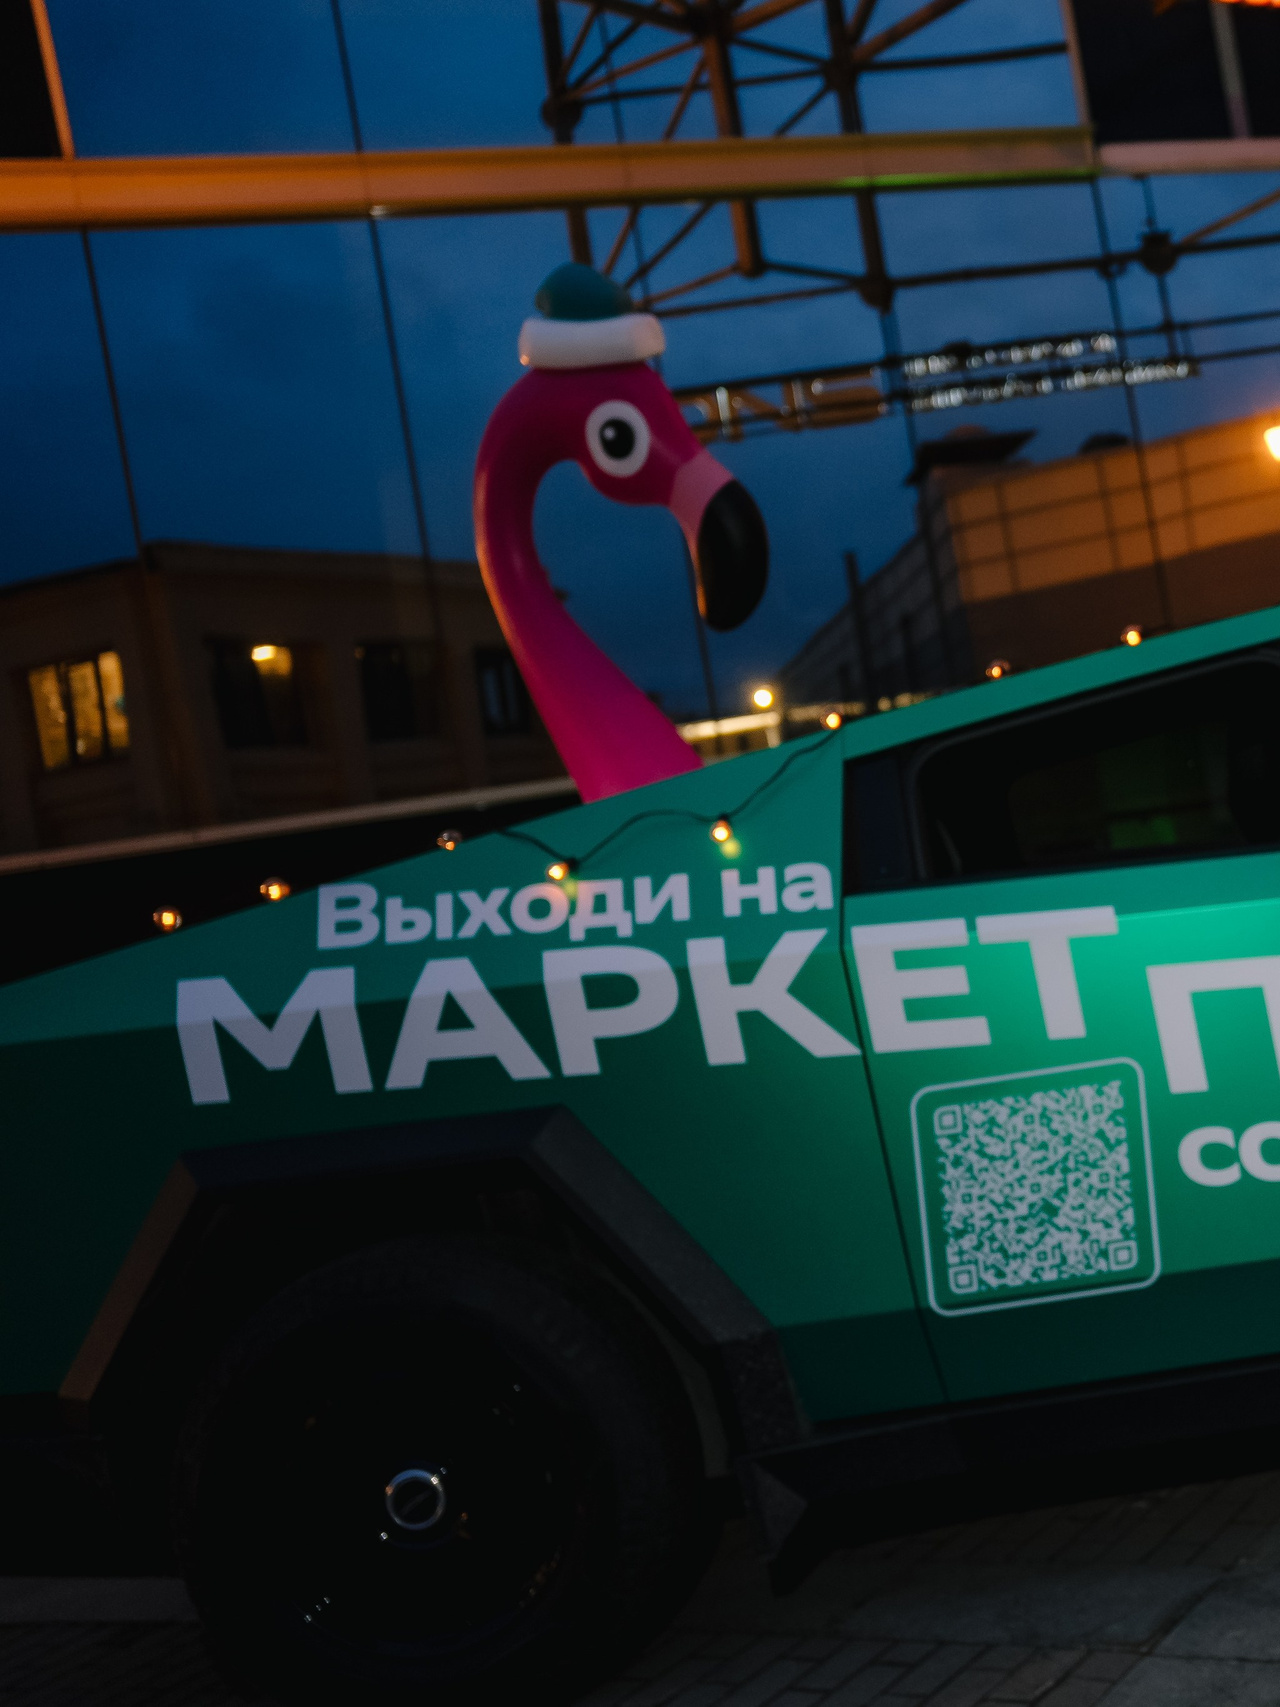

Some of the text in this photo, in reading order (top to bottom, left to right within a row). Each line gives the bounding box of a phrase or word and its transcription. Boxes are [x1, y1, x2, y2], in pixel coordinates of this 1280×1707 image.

[316, 861, 835, 950] Выходи на
[175, 904, 1119, 1106] МАРКЕТ
